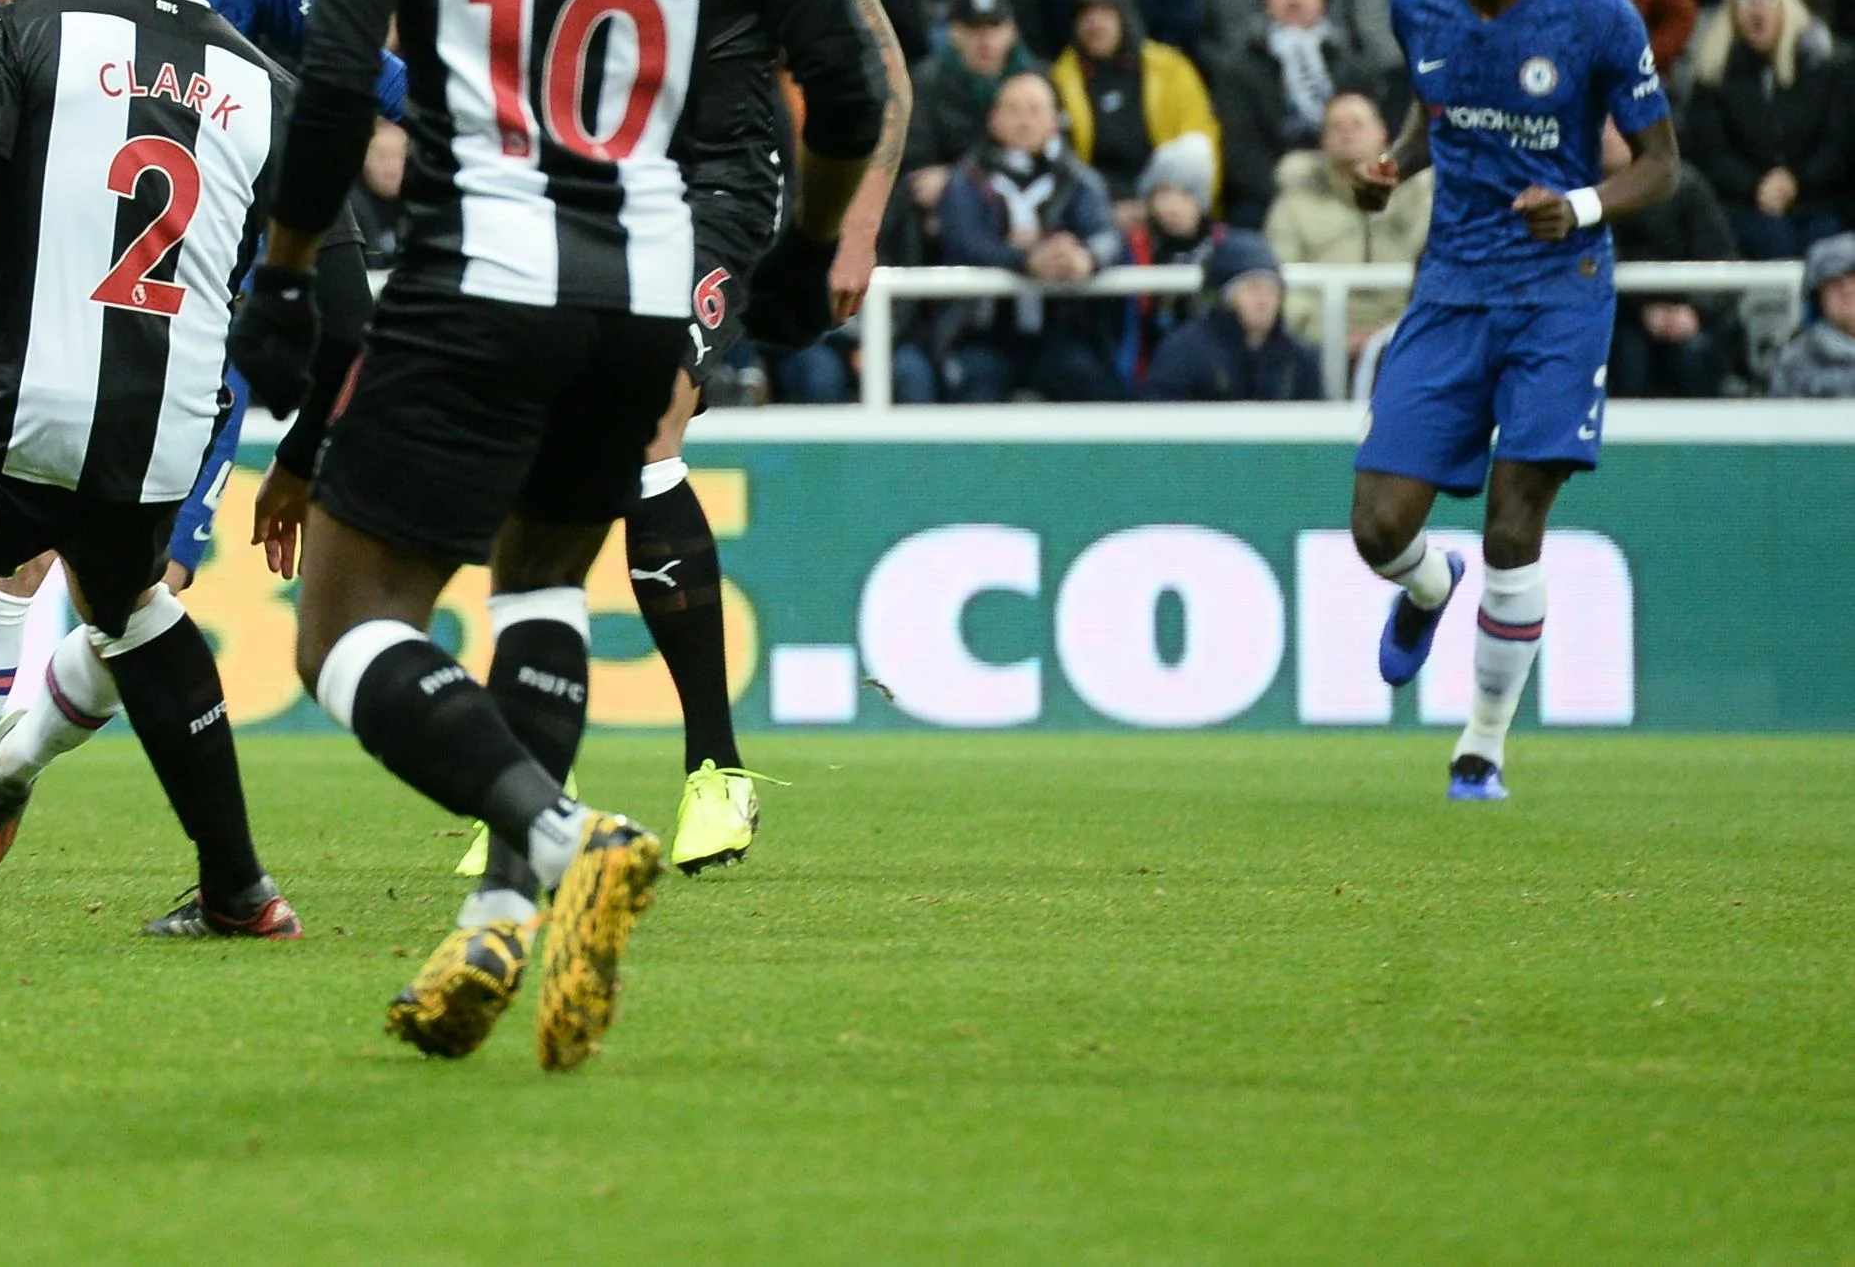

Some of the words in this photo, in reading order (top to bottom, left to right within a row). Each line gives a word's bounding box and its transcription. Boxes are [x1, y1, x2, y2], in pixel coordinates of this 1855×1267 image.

[99, 60, 243, 132] CLARK
[1445, 105, 1560, 136] YOKOHAMA
[90, 134, 203, 317] 2
[693, 266, 732, 330] 6
